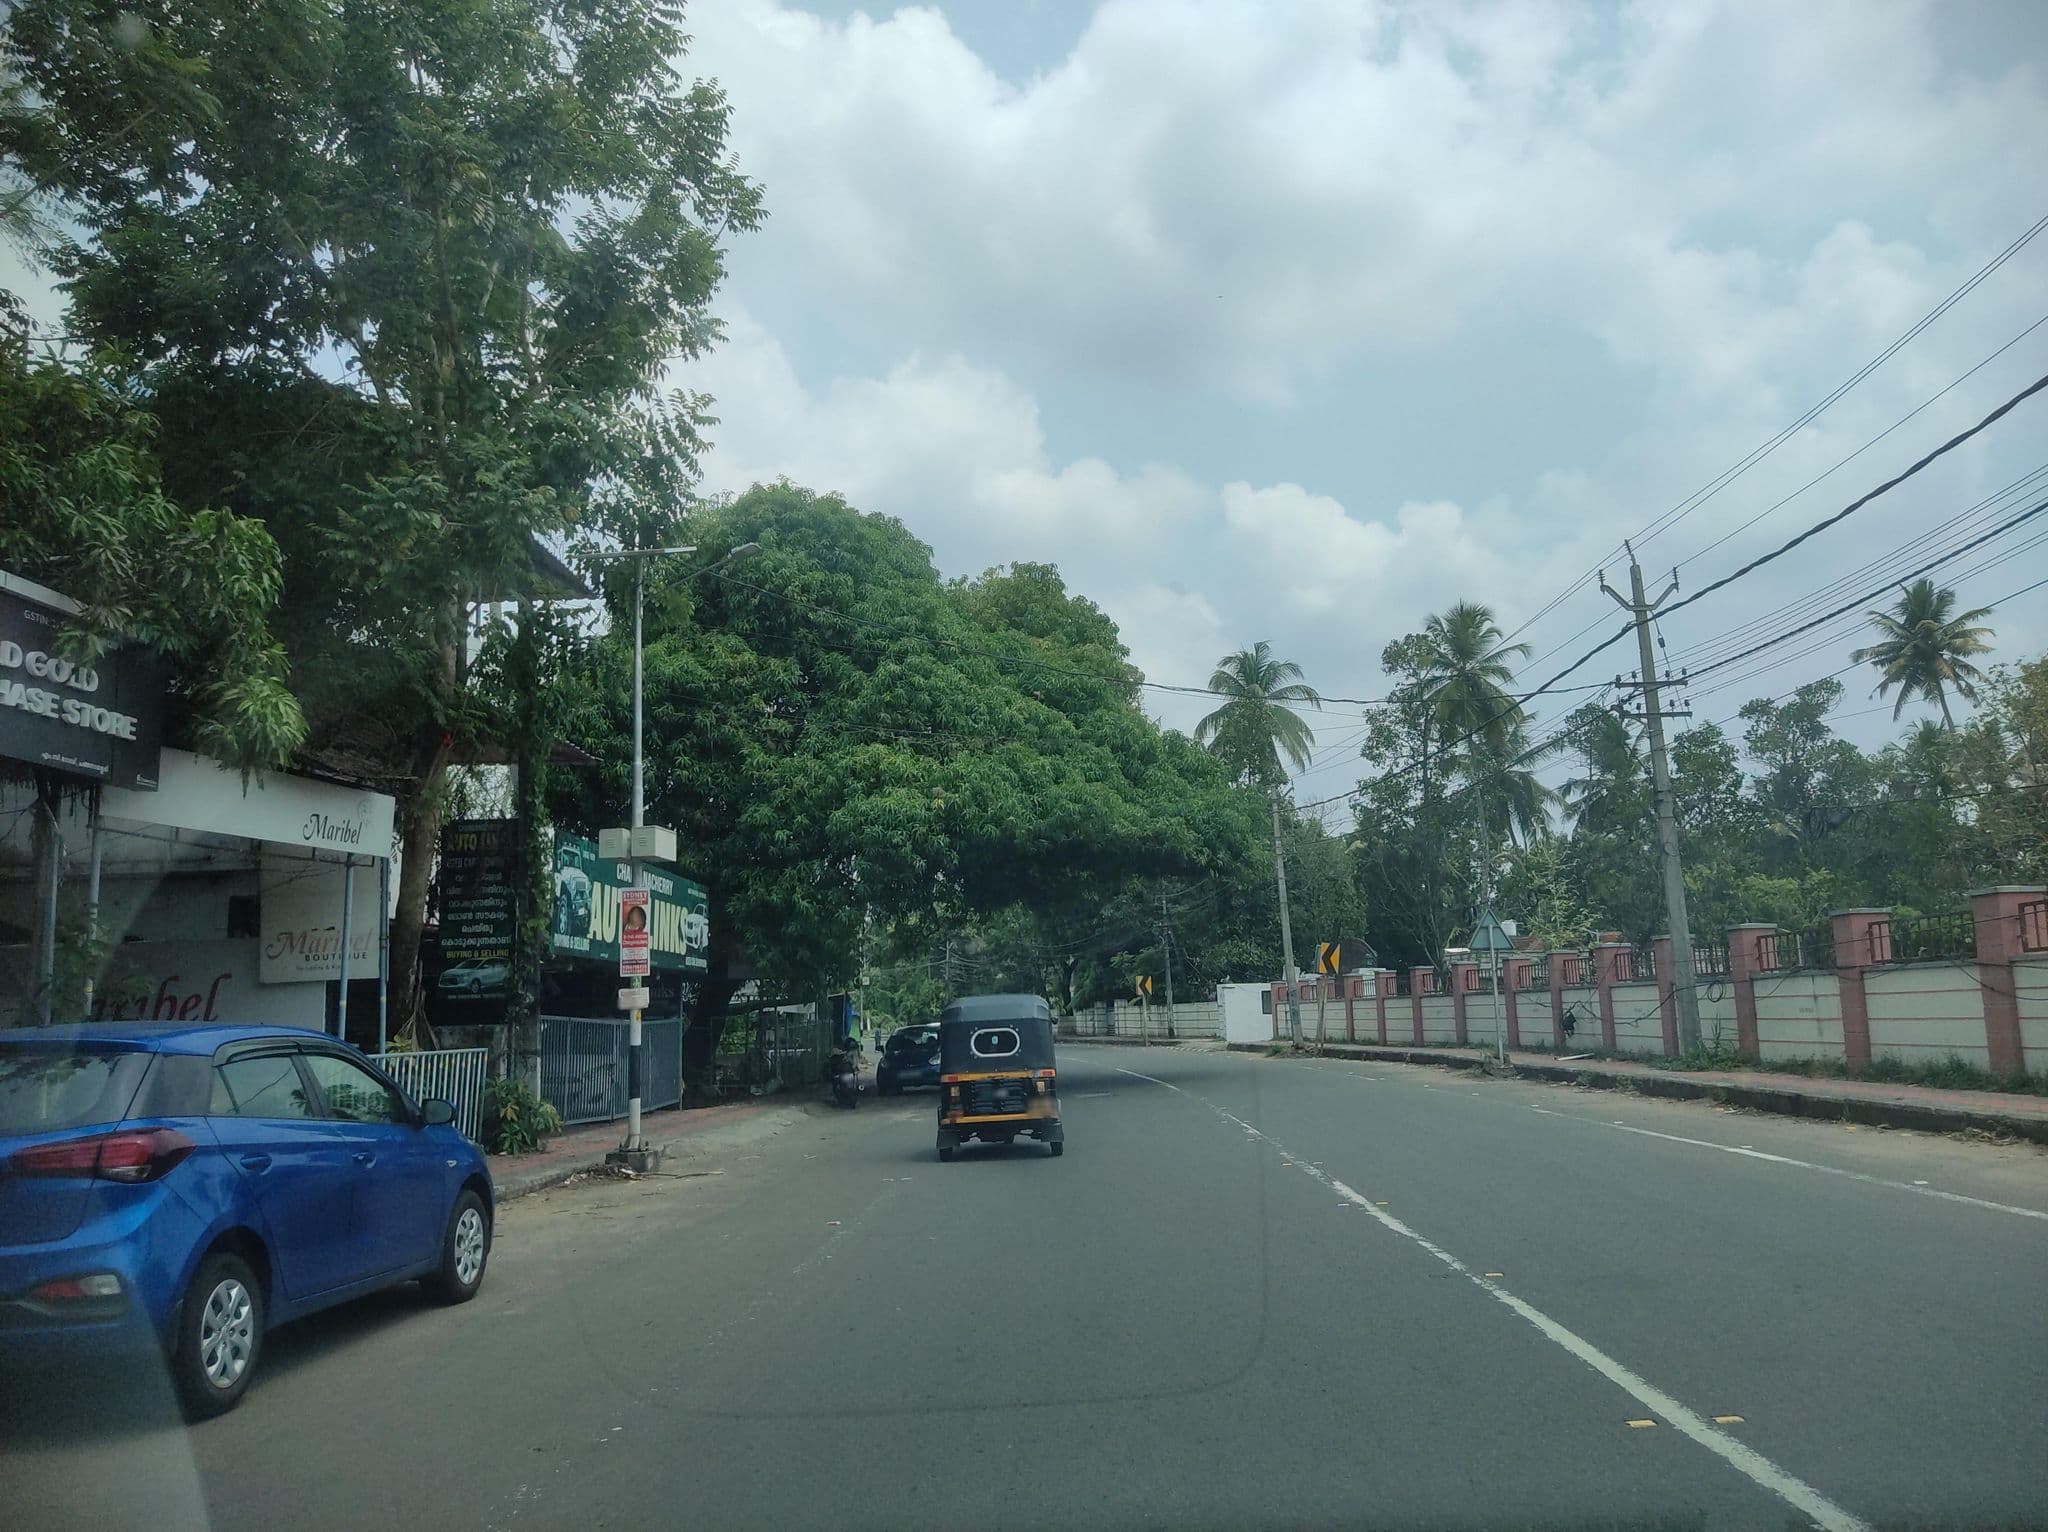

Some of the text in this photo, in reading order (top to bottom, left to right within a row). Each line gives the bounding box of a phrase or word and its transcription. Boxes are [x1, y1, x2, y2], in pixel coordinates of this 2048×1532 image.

[25, 651, 99, 692] GOLD
[61, 698, 138, 741] STORE
[302, 813, 362, 846] Maribel
[304, 951, 369, 961] BOUTIUE
[446, 950, 472, 959] BUYING
[480, 949, 509, 958] SELLING
